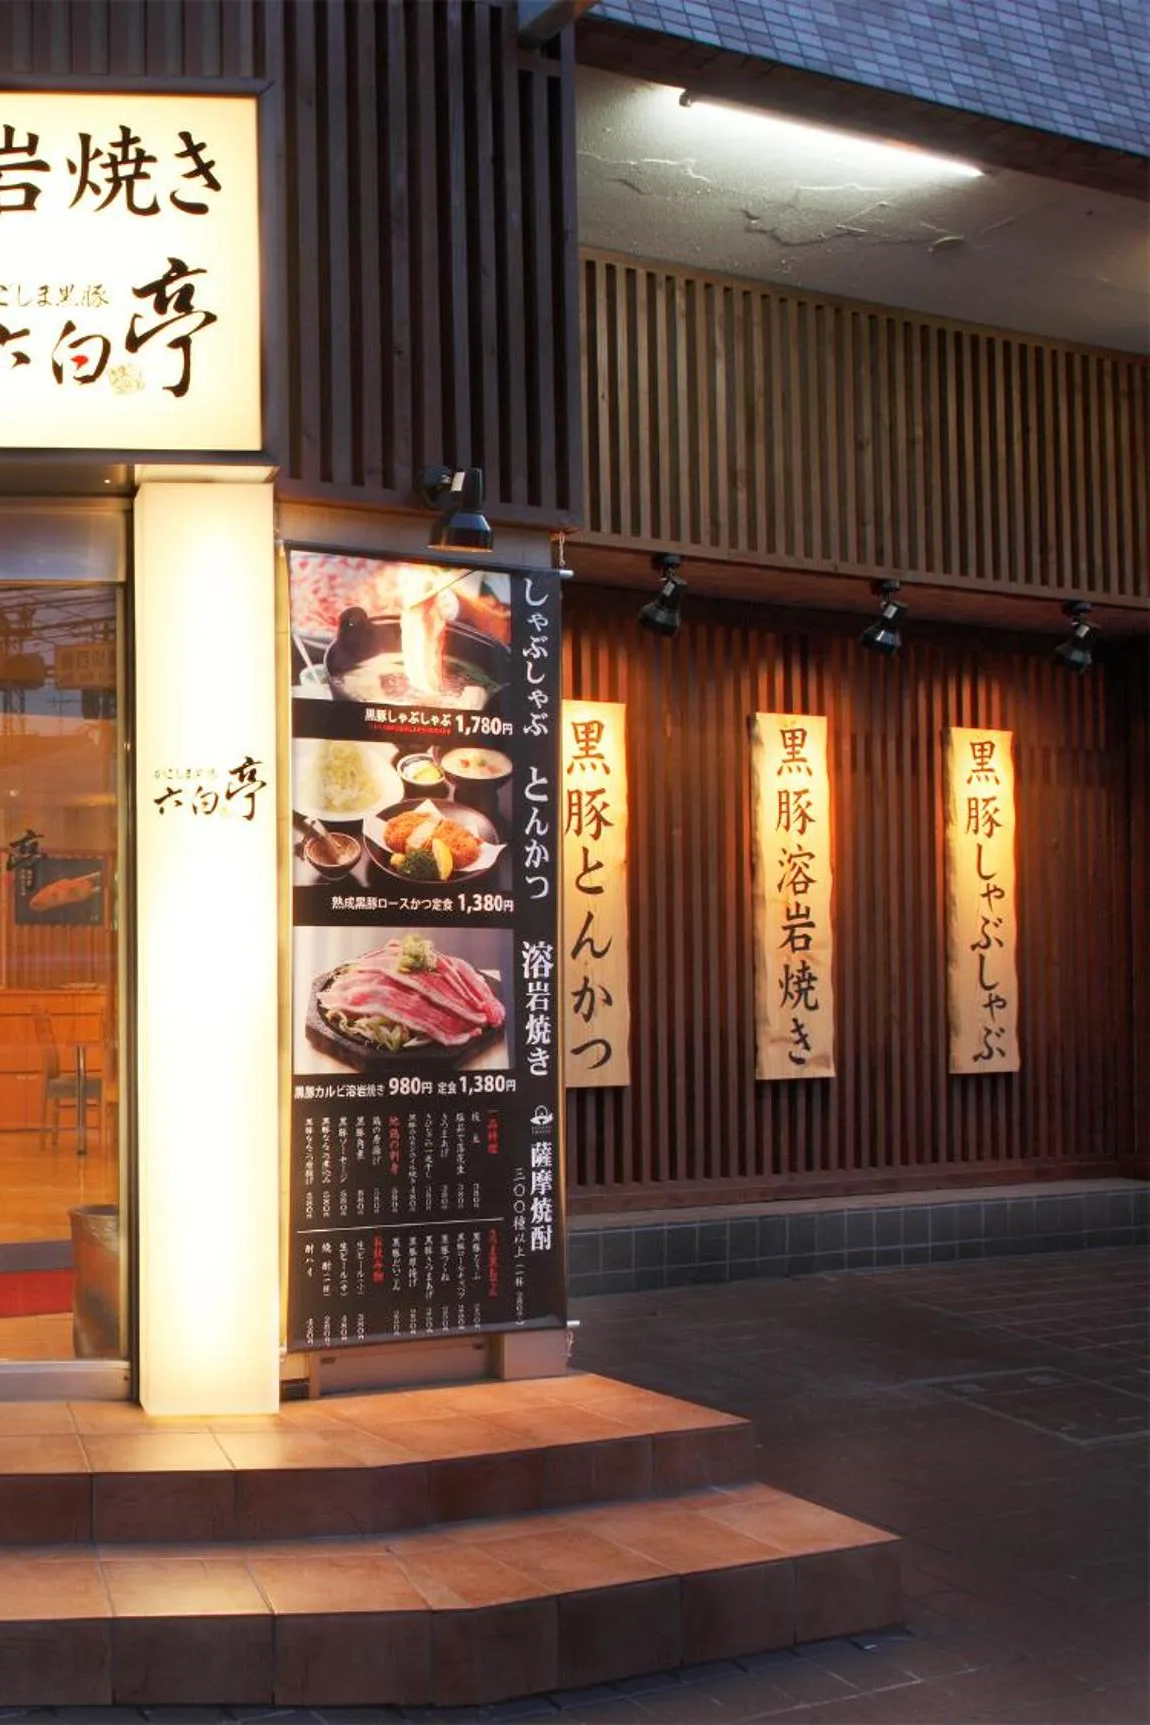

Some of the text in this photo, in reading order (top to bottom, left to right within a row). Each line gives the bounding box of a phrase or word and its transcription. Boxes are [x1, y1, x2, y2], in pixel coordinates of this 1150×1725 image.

[364, 707, 452, 728] 黒豚しゃぶしゃぶ
[454, 714, 514, 736] 1,780円
[522, 577, 550, 737] しゃぶしゃぶ
[523, 765, 550, 899] とんかつ
[564, 719, 615, 1070] 黒豚とんかつ
[775, 726, 820, 1066] 黒豚溶岩焼き
[457, 893, 515, 915] 1,380円
[965, 739, 1008, 1063] 黒豚しゃぶしゃぶ
[521, 940, 555, 1077] 溶岩焼き
[293, 1074, 517, 1100] 黒豚カルビ溶岩焼き 980円 定食 1,380円
[530, 1141, 553, 1252] 薩摩焼酎
